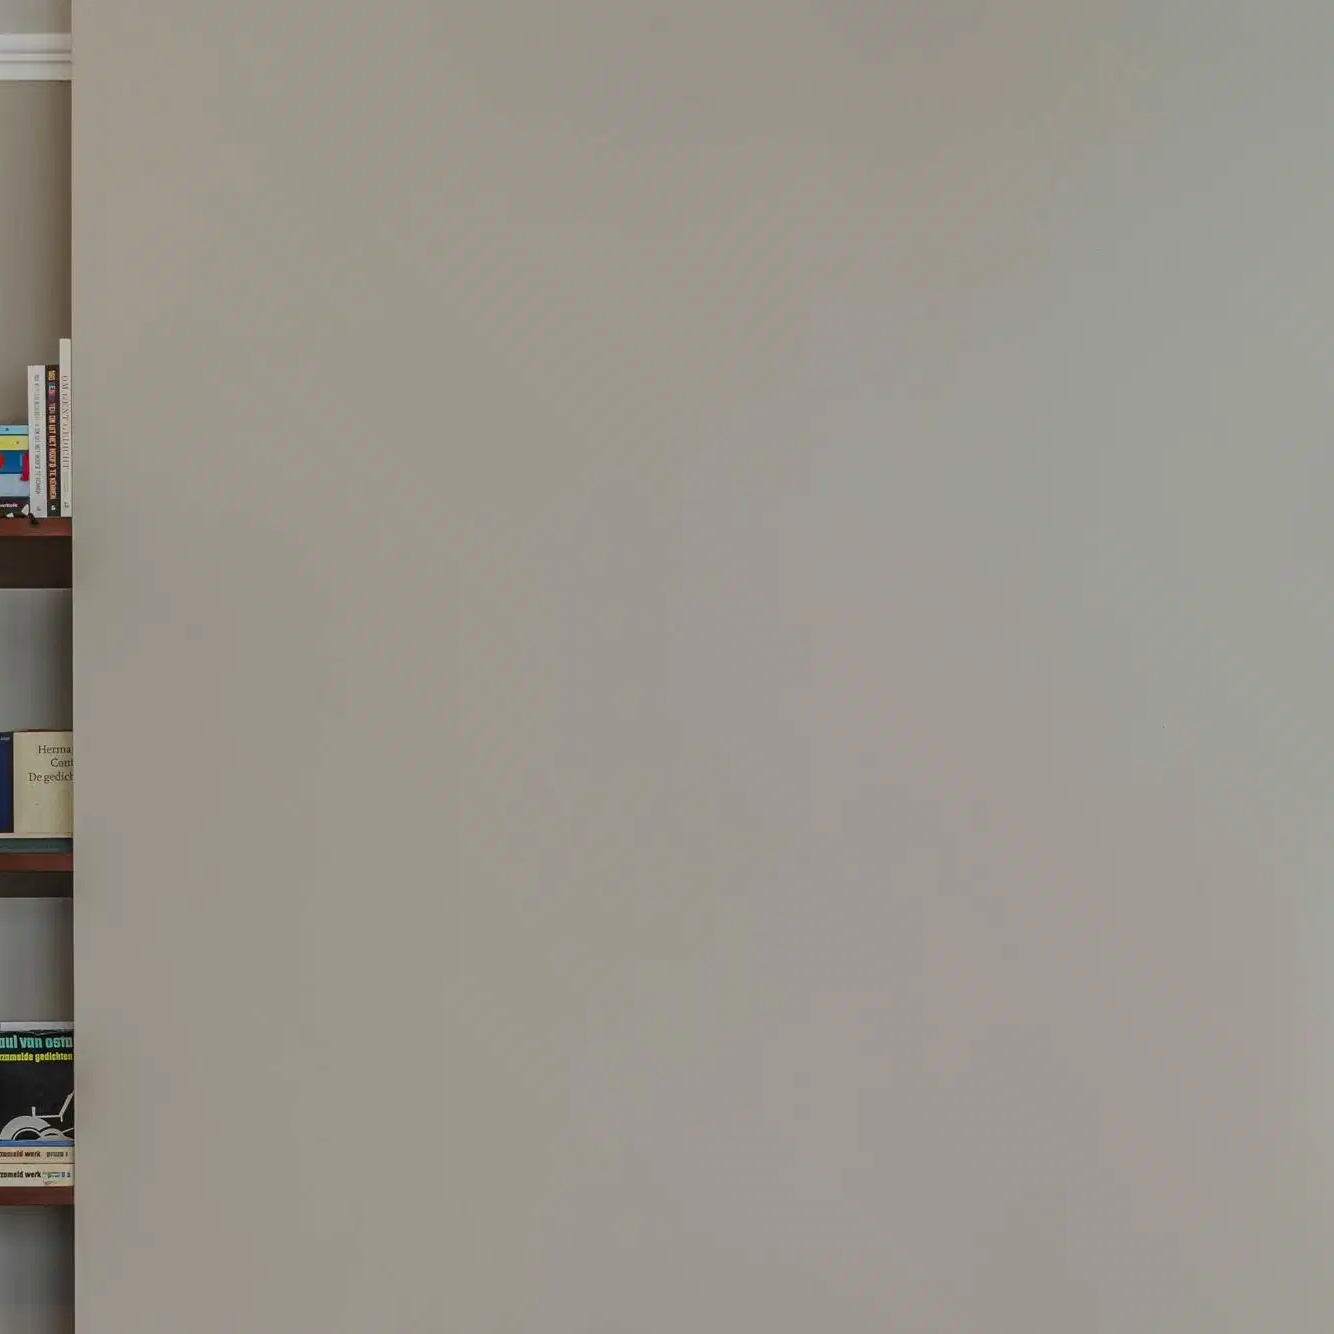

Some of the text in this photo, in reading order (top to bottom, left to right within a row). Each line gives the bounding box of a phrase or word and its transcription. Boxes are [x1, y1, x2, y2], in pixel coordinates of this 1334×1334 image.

[28, 772, 43, 782] De
[19, 1036, 42, 1049] van
[34, 1052, 73, 1063] gedichten
[25, 1150, 41, 1158] werk
[25, 1170, 41, 1178] werk
